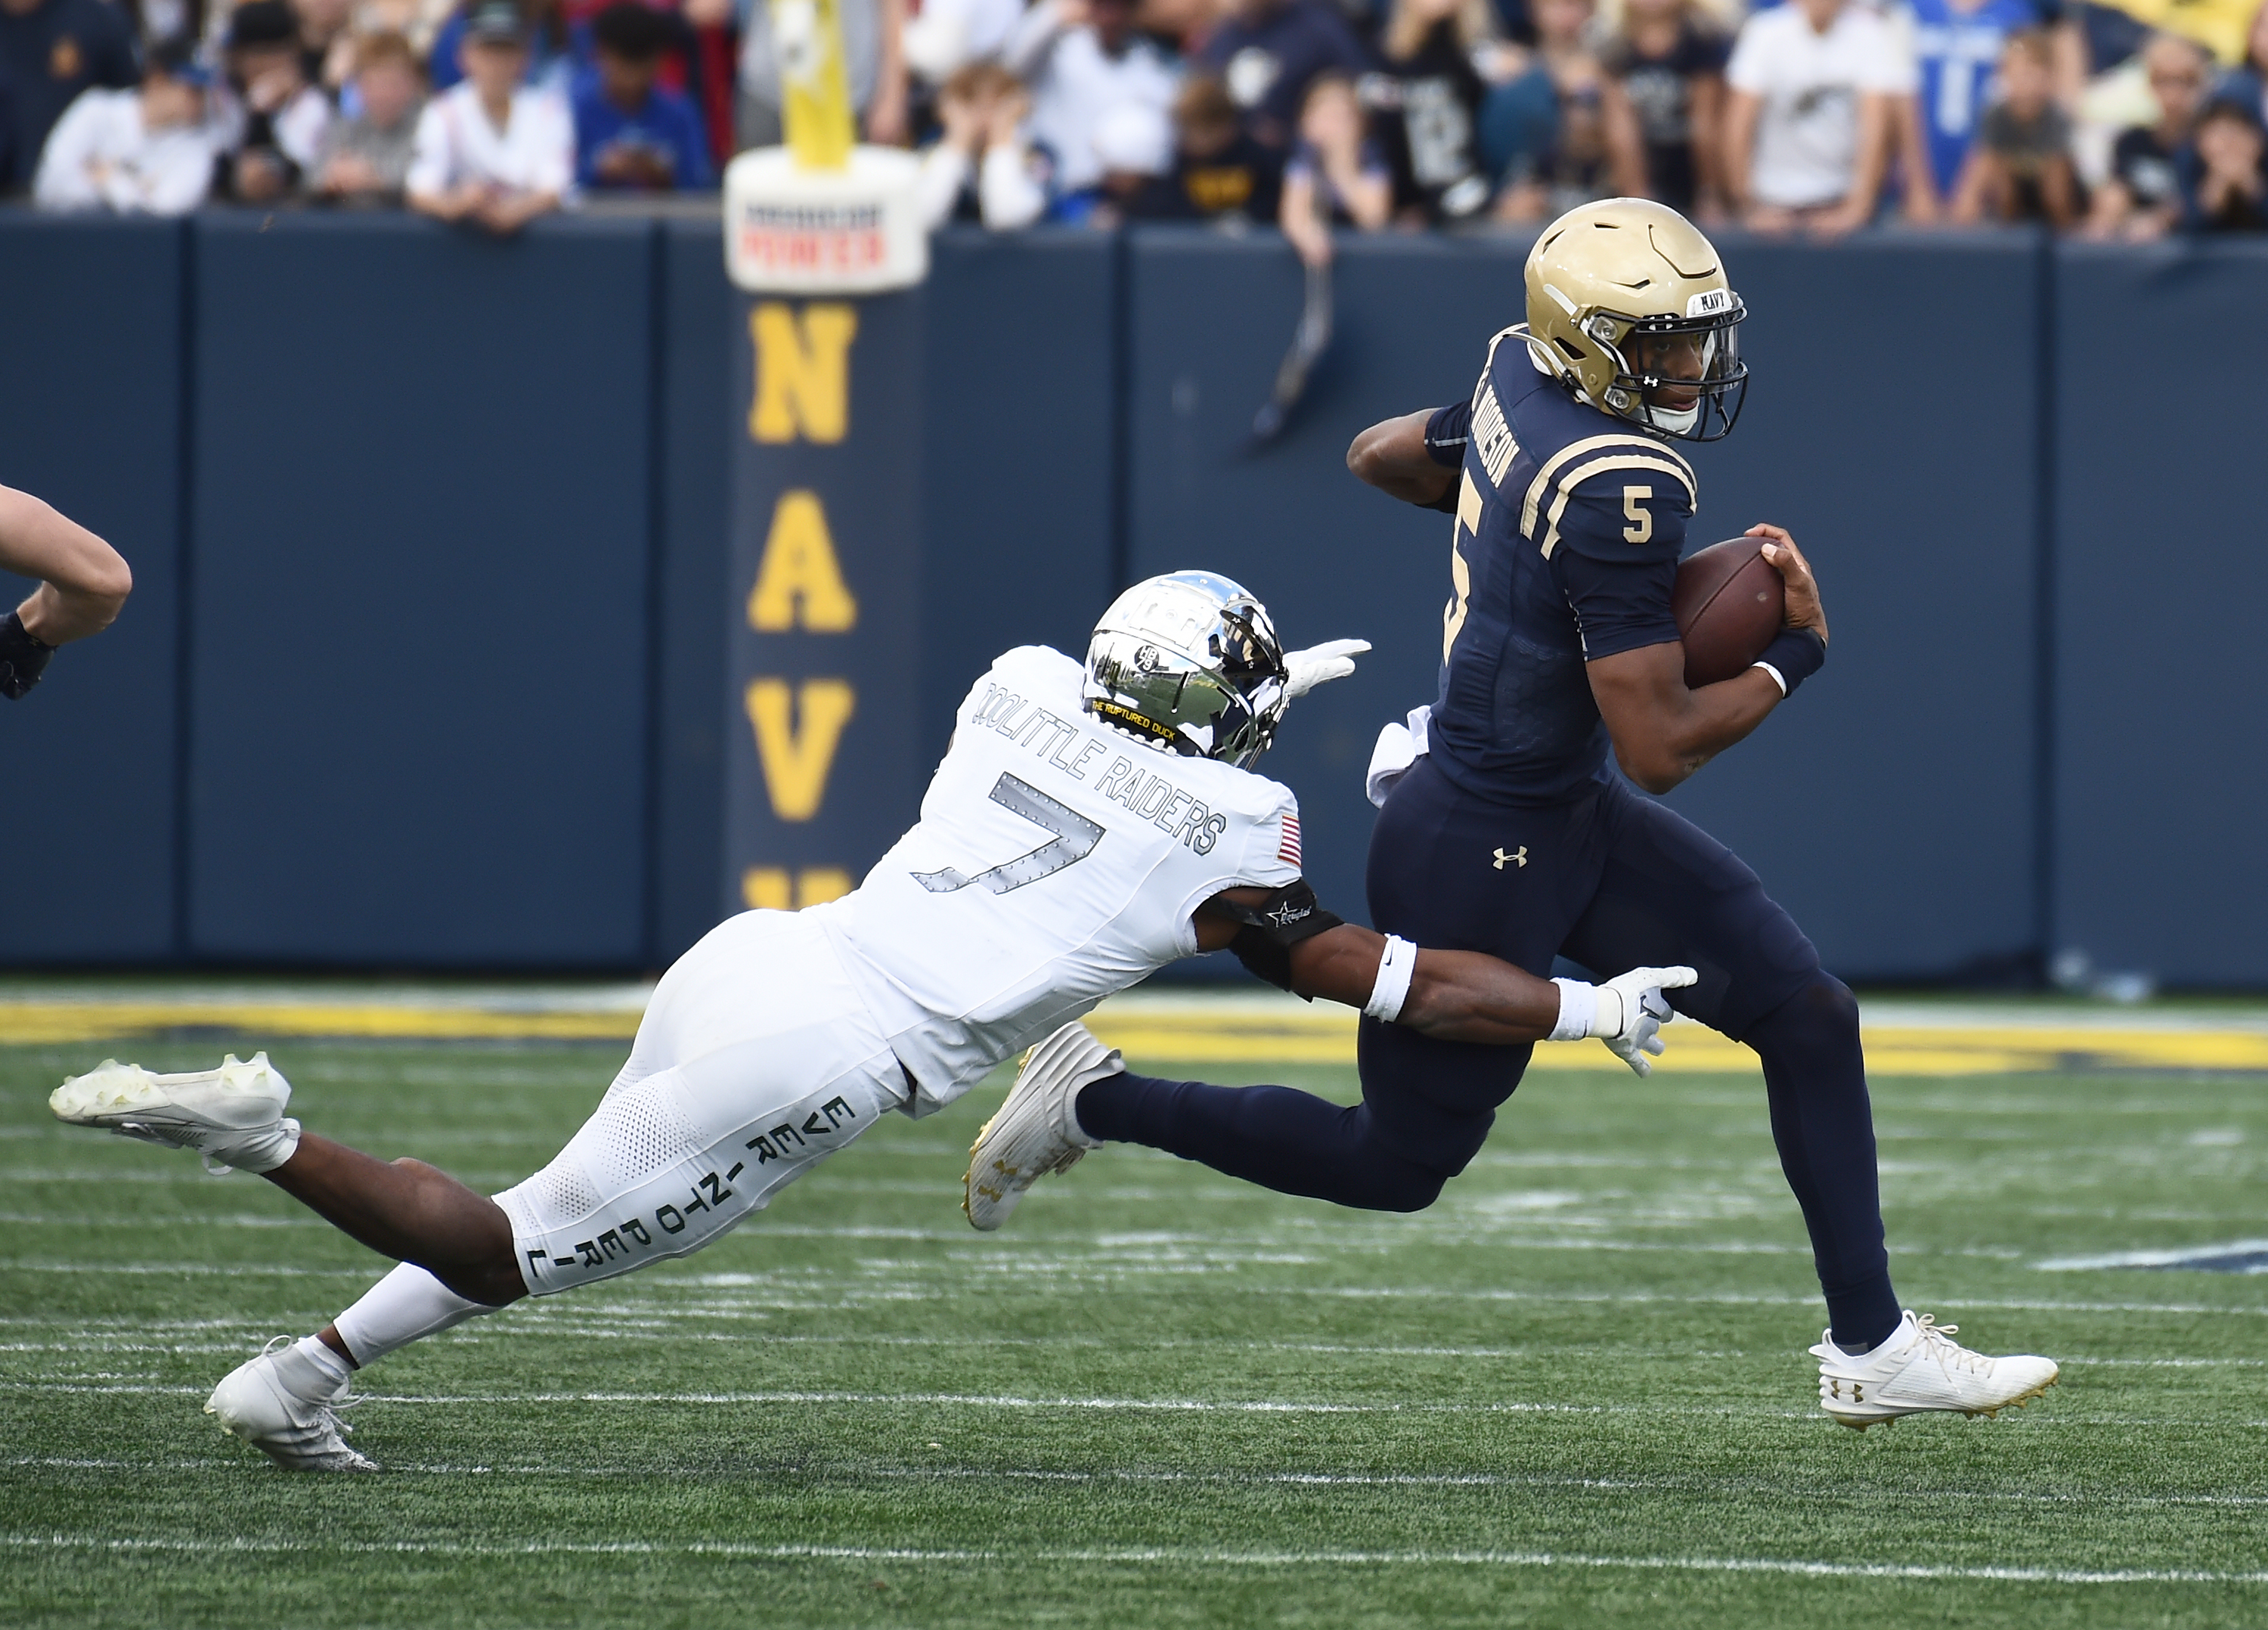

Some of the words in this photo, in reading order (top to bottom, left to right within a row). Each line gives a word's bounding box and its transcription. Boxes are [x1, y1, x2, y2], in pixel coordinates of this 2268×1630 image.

[1700, 292, 1724, 311] NAVY
[1622, 485, 1653, 544] 5
[746, 300, 859, 912] NAV
[1136, 655, 1154, 671] 79
[1139, 645, 1158, 661] HB
[1092, 700, 1105, 711] THE
[1105, 703, 1151, 728] RUPTURED
[1151, 722, 1176, 741] DUCK
[909, 770, 1107, 895] 7
[1094, 755, 1226, 857] RAIDERS
[745, 1095, 856, 1165] EVER
[655, 1161, 745, 1235] INTO
[526, 1218, 652, 1278] PERIL
